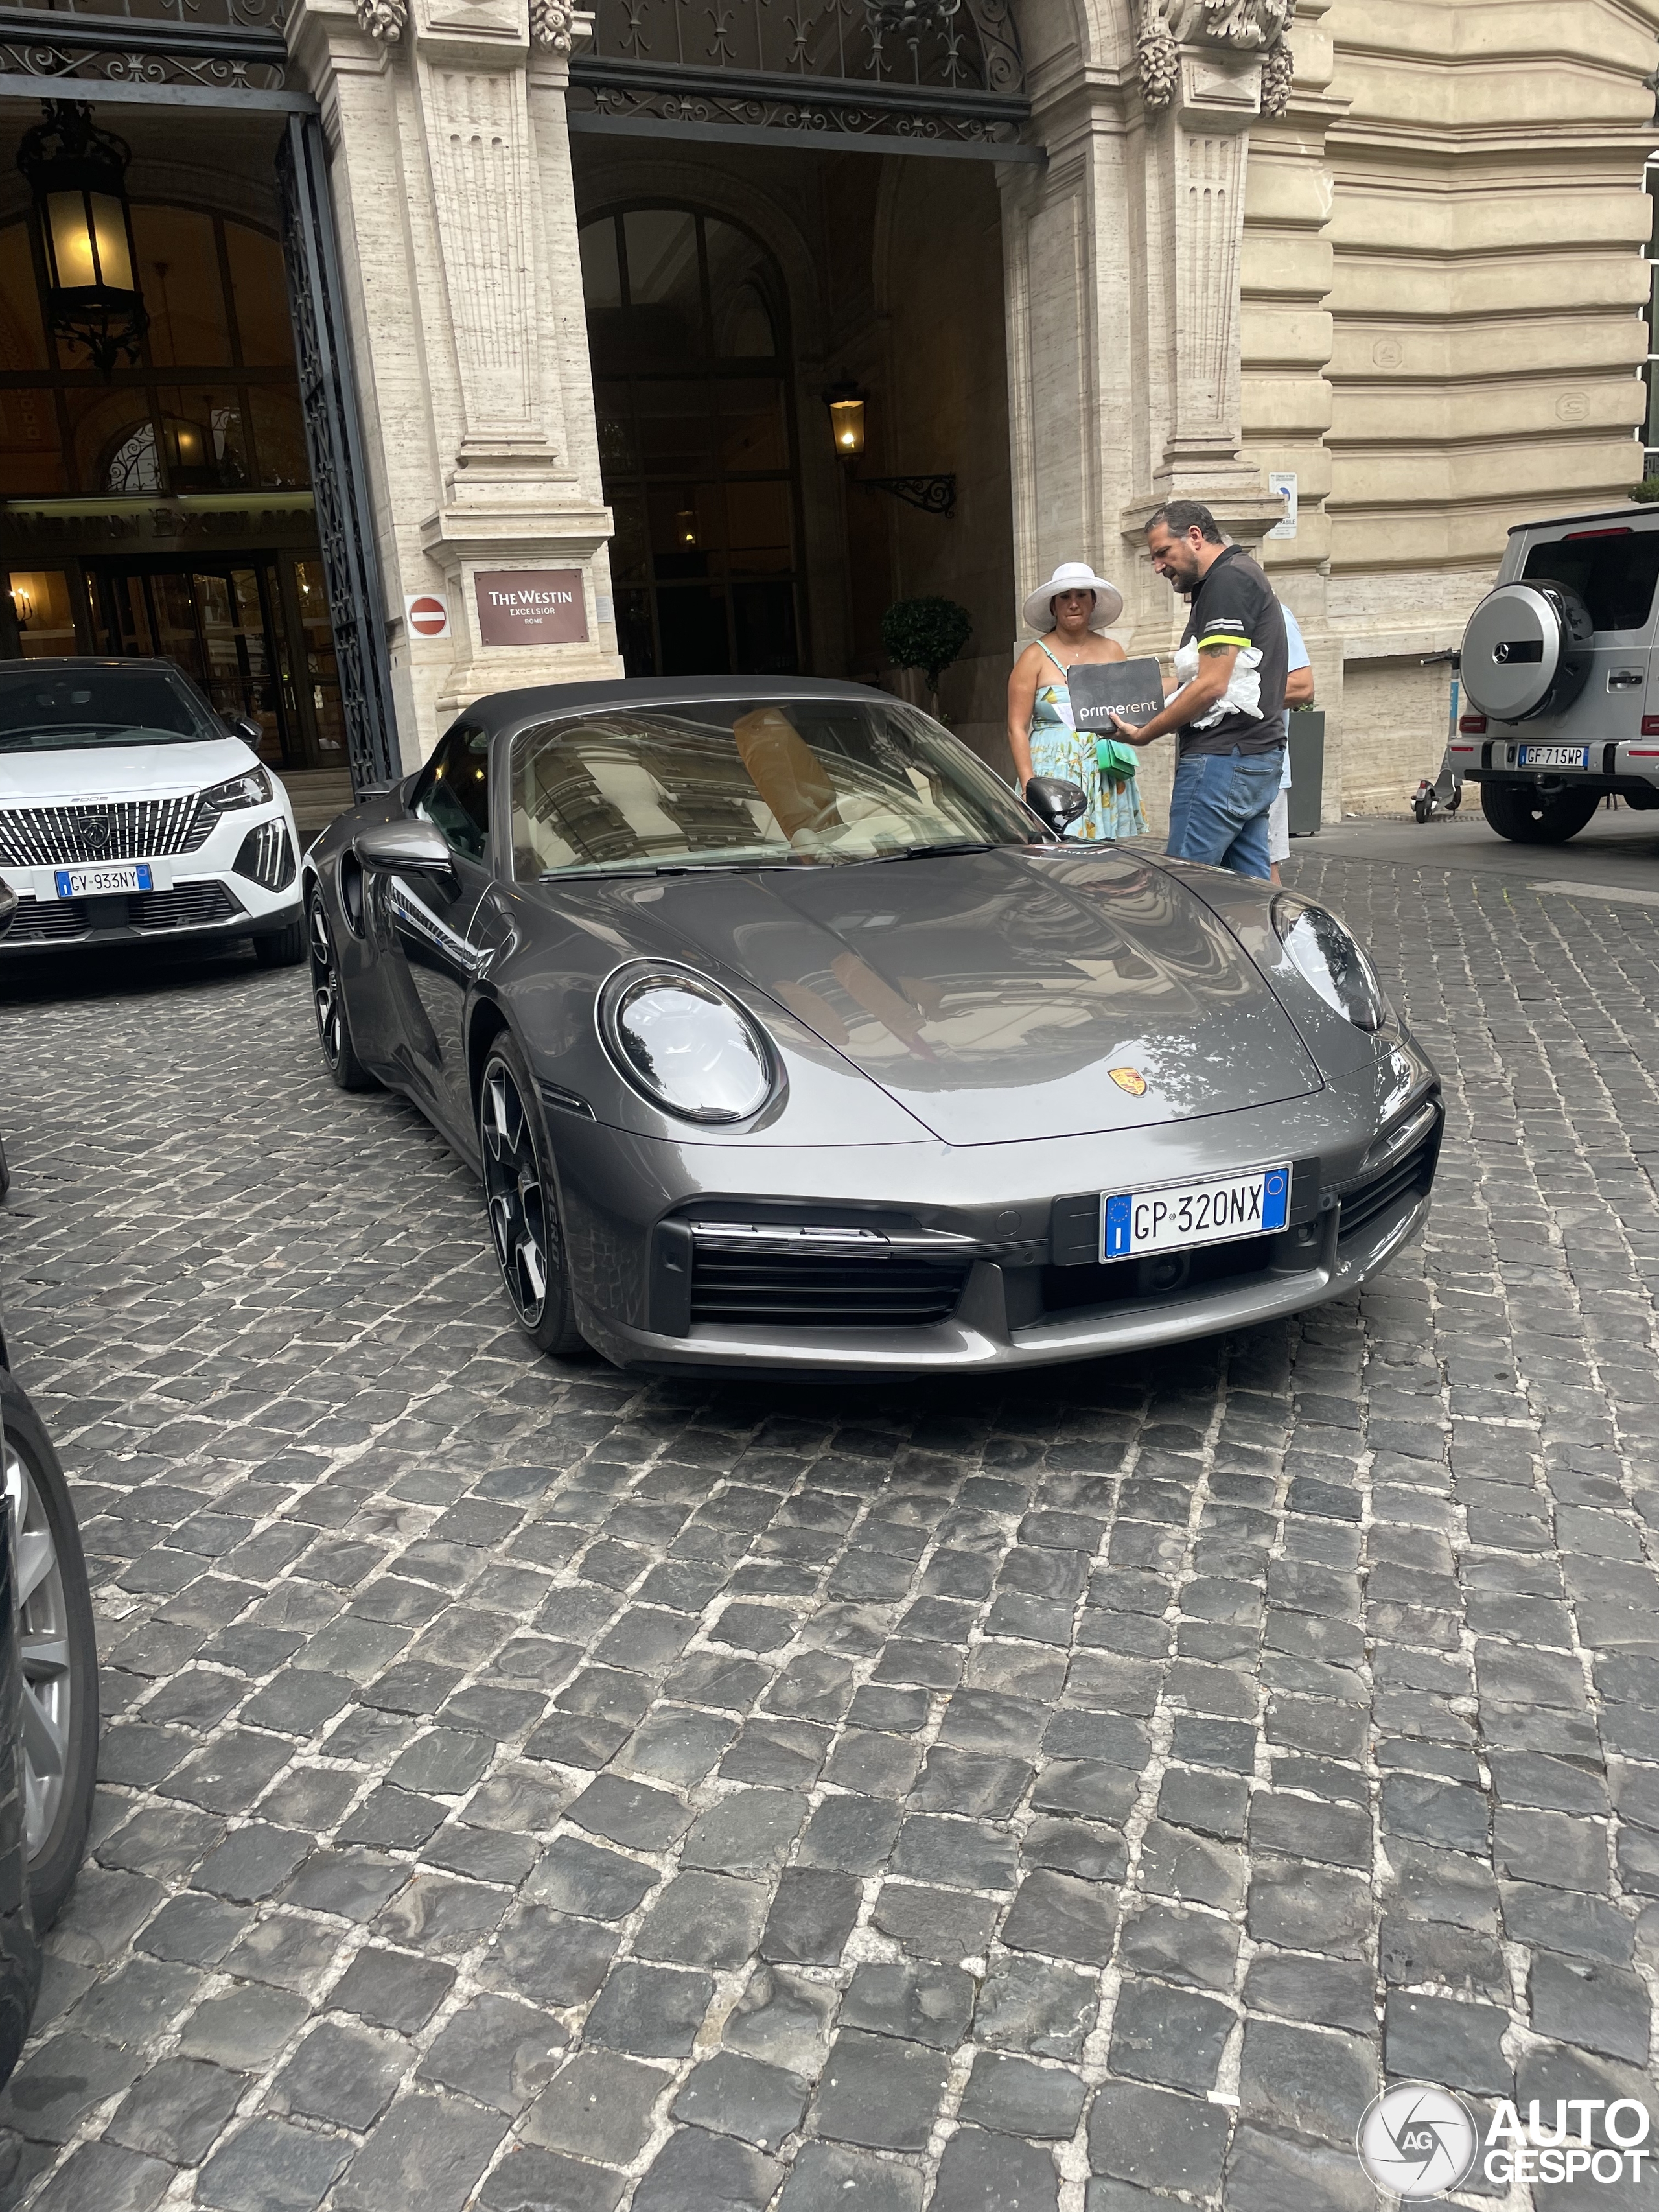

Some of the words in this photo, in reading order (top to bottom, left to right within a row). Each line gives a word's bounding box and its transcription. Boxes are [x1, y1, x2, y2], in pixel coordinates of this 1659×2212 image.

[488, 591, 518, 606] THE
[517, 590, 572, 605] WESTIN
[509, 607, 555, 616] EXCELSIOR
[1080, 700, 1158, 721] primerent
[1528, 748, 1542, 762] GF
[1546, 749, 1582, 764] 715WP
[71, 875, 86, 891] GV
[94, 871, 135, 889] 933NY
[1135, 1201, 1167, 1239] GP
[1178, 1183, 1262, 1232] 320NX
